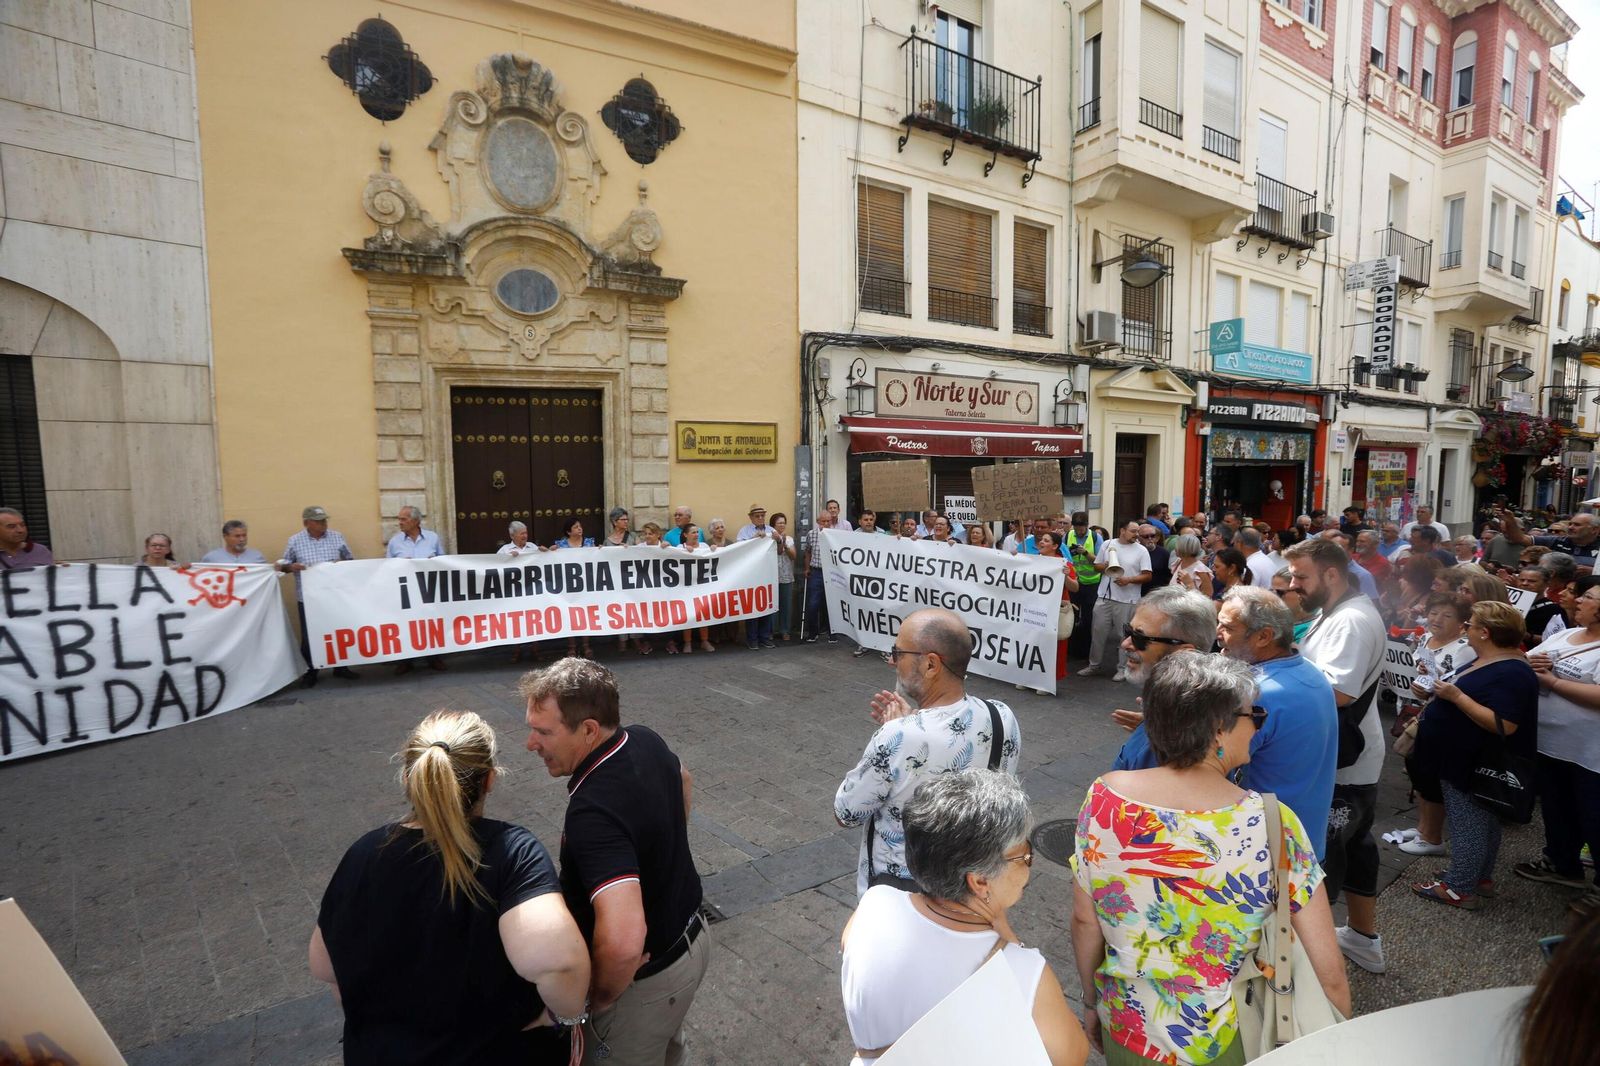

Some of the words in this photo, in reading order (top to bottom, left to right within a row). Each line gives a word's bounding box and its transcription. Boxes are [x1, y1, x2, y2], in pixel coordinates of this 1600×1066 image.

[1373, 285, 1393, 363] ABOGADOS
[913, 376, 964, 402] Norte
[968, 387, 979, 409] y
[980, 381, 1011, 405] Sur
[944, 408, 966, 418] Taberna
[967, 410, 986, 418] Selecta
[1209, 405, 1248, 416] PIZZERIA
[698, 436, 720, 445] JUNTA
[724, 436, 732, 445] DE
[886, 436, 928, 450] Pintxos
[1032, 440, 1060, 452] Tapas
[698, 447, 731, 456] Delegación
[975, 470, 989, 481] EL
[993, 465, 1023, 480] PSOE
[1029, 462, 1058, 476] ABRE
[993, 481, 1007, 491] EL
[1010, 475, 1053, 489] CENTRO
[980, 494, 990, 502] EL
[1008, 489, 1018, 498] DE
[1021, 485, 1057, 497] MORENO
[995, 498, 1025, 511] CIERRA
[1001, 505, 1048, 519] CENTRO
[620, 558, 719, 590] EXISTE!
[886, 551, 978, 583] NUESTRA
[984, 566, 1054, 595] SALUD
[853, 576, 883, 598] NO
[888, 583, 908, 602] SE
[915, 586, 1021, 623] NEGOCIA!!
[324, 623, 401, 665] ¡POR
[409, 618, 445, 650] UN
[453, 606, 562, 645] CENTRO
[568, 605, 602, 631] DE
[607, 599, 687, 630] SALUD
[693, 584, 773, 622] NUEVO!
[841, 600, 854, 628] EL
[984, 633, 1008, 665] SE
[1016, 640, 1046, 672] VA
[0, 665, 226, 755] NIDAD
